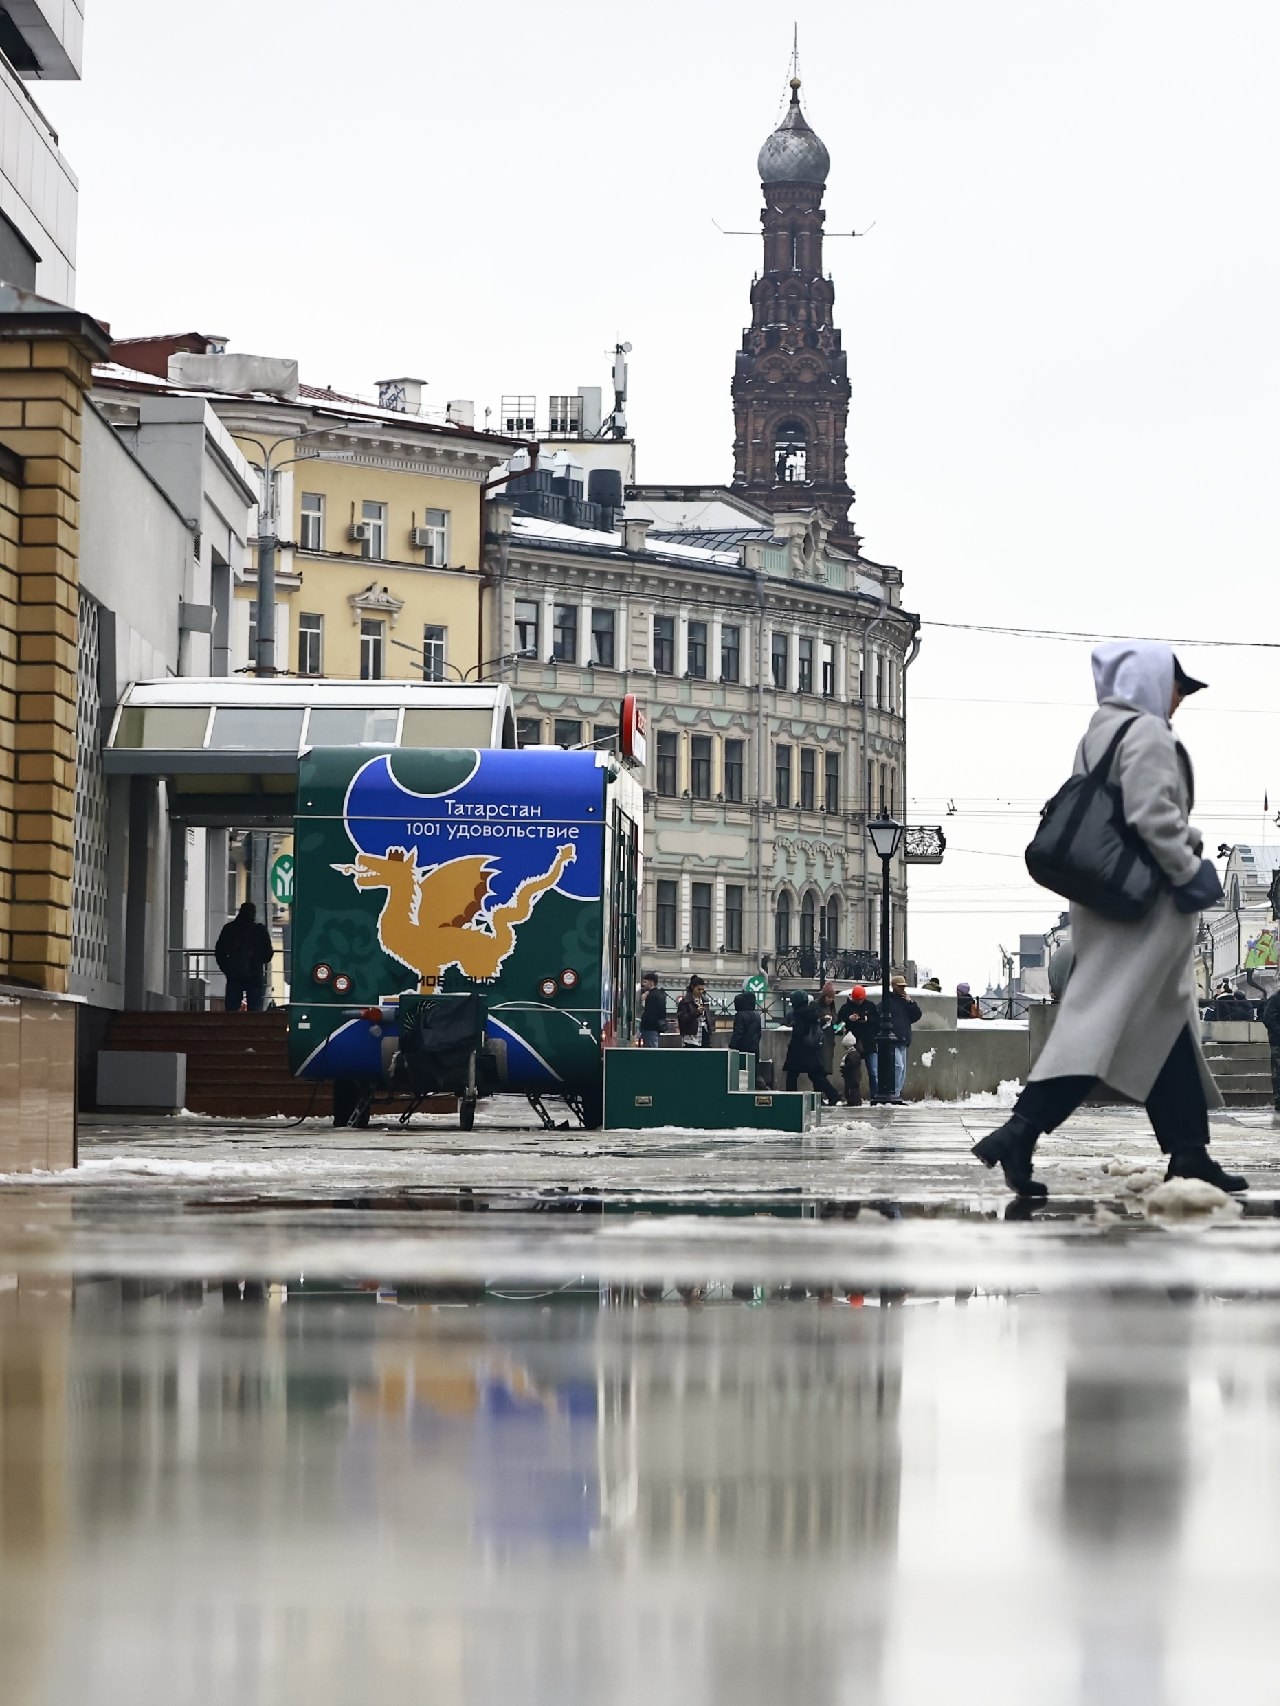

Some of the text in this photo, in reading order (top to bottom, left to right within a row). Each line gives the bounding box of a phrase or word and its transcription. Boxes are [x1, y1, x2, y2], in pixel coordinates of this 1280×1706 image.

[445, 799, 541, 820] Татарстан
[406, 822, 580, 840] 1001 удовольствие
